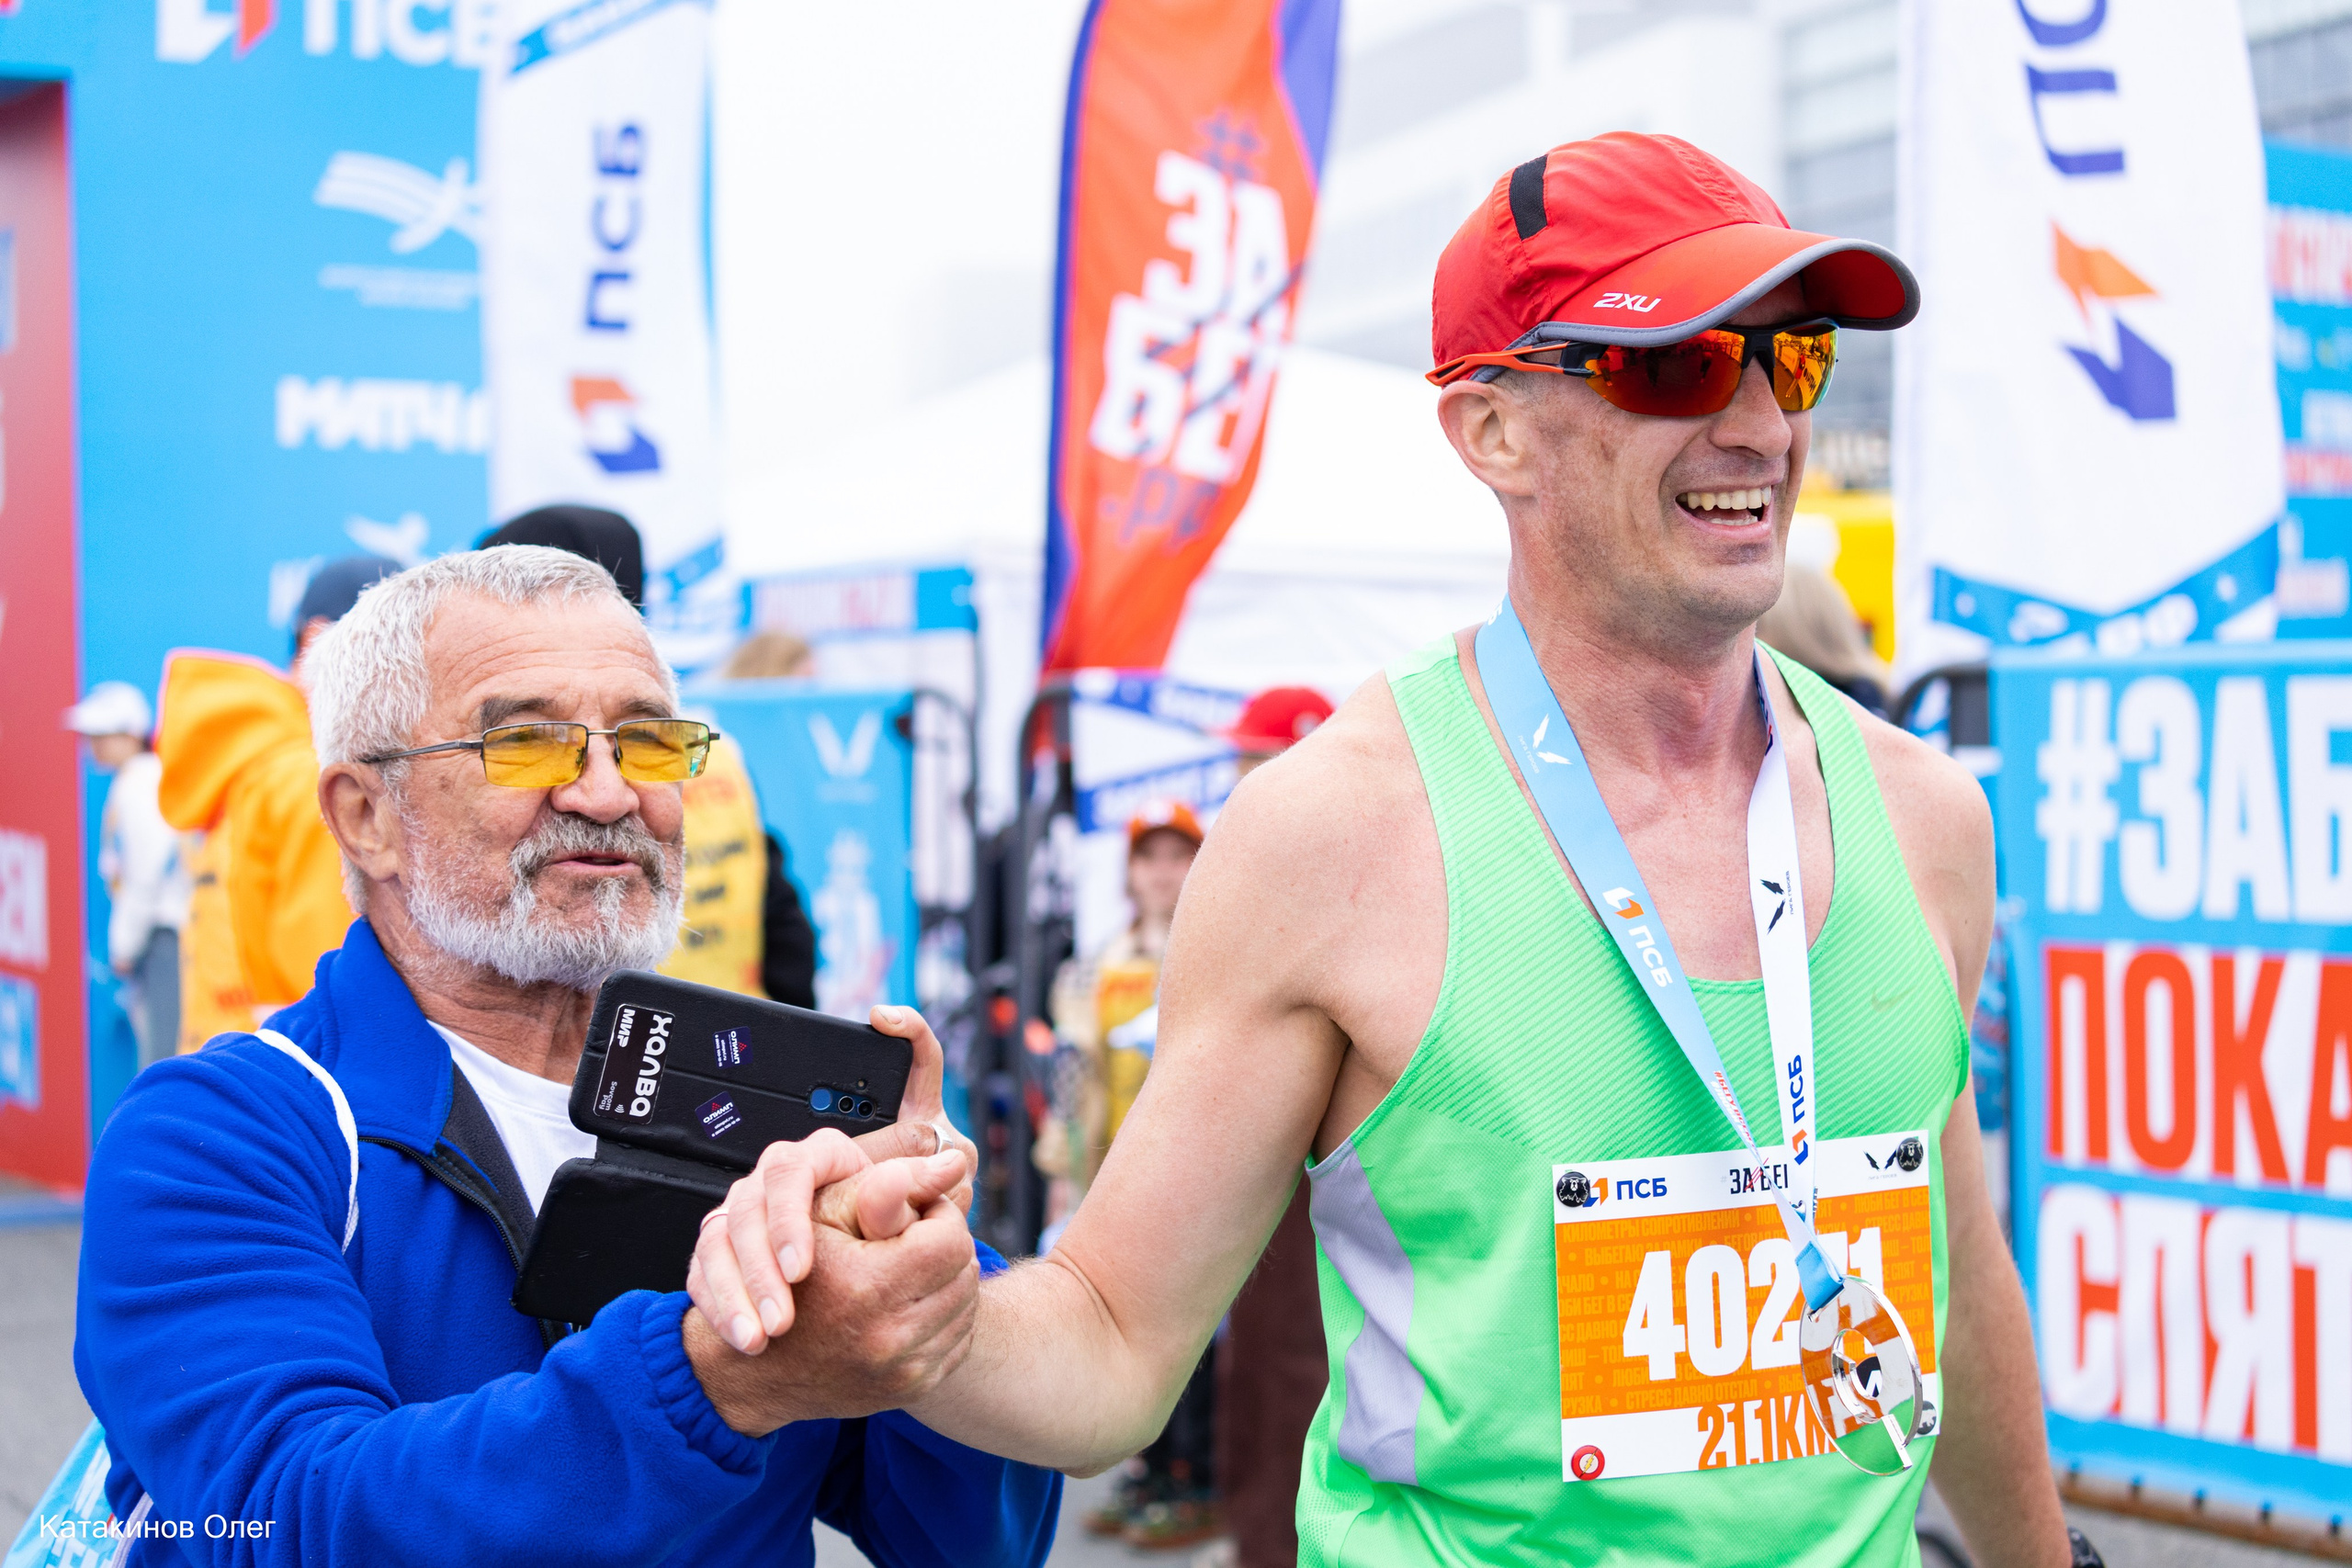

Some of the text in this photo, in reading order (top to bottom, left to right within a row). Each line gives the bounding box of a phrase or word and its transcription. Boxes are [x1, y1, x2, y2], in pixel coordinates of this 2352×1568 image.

[582, 121, 645, 333] ПСБ
[1592, 291, 1662, 313] 2XU
[1628, 925, 1673, 987] ПСБ
[617, 1008, 636, 1048] МИР
[730, 1030, 741, 1065] ОЛИМП
[1788, 1055, 1805, 1124] ПСБ
[703, 1101, 734, 1124] ОЛИМП
[1616, 1178, 1668, 1201] ПСБ
